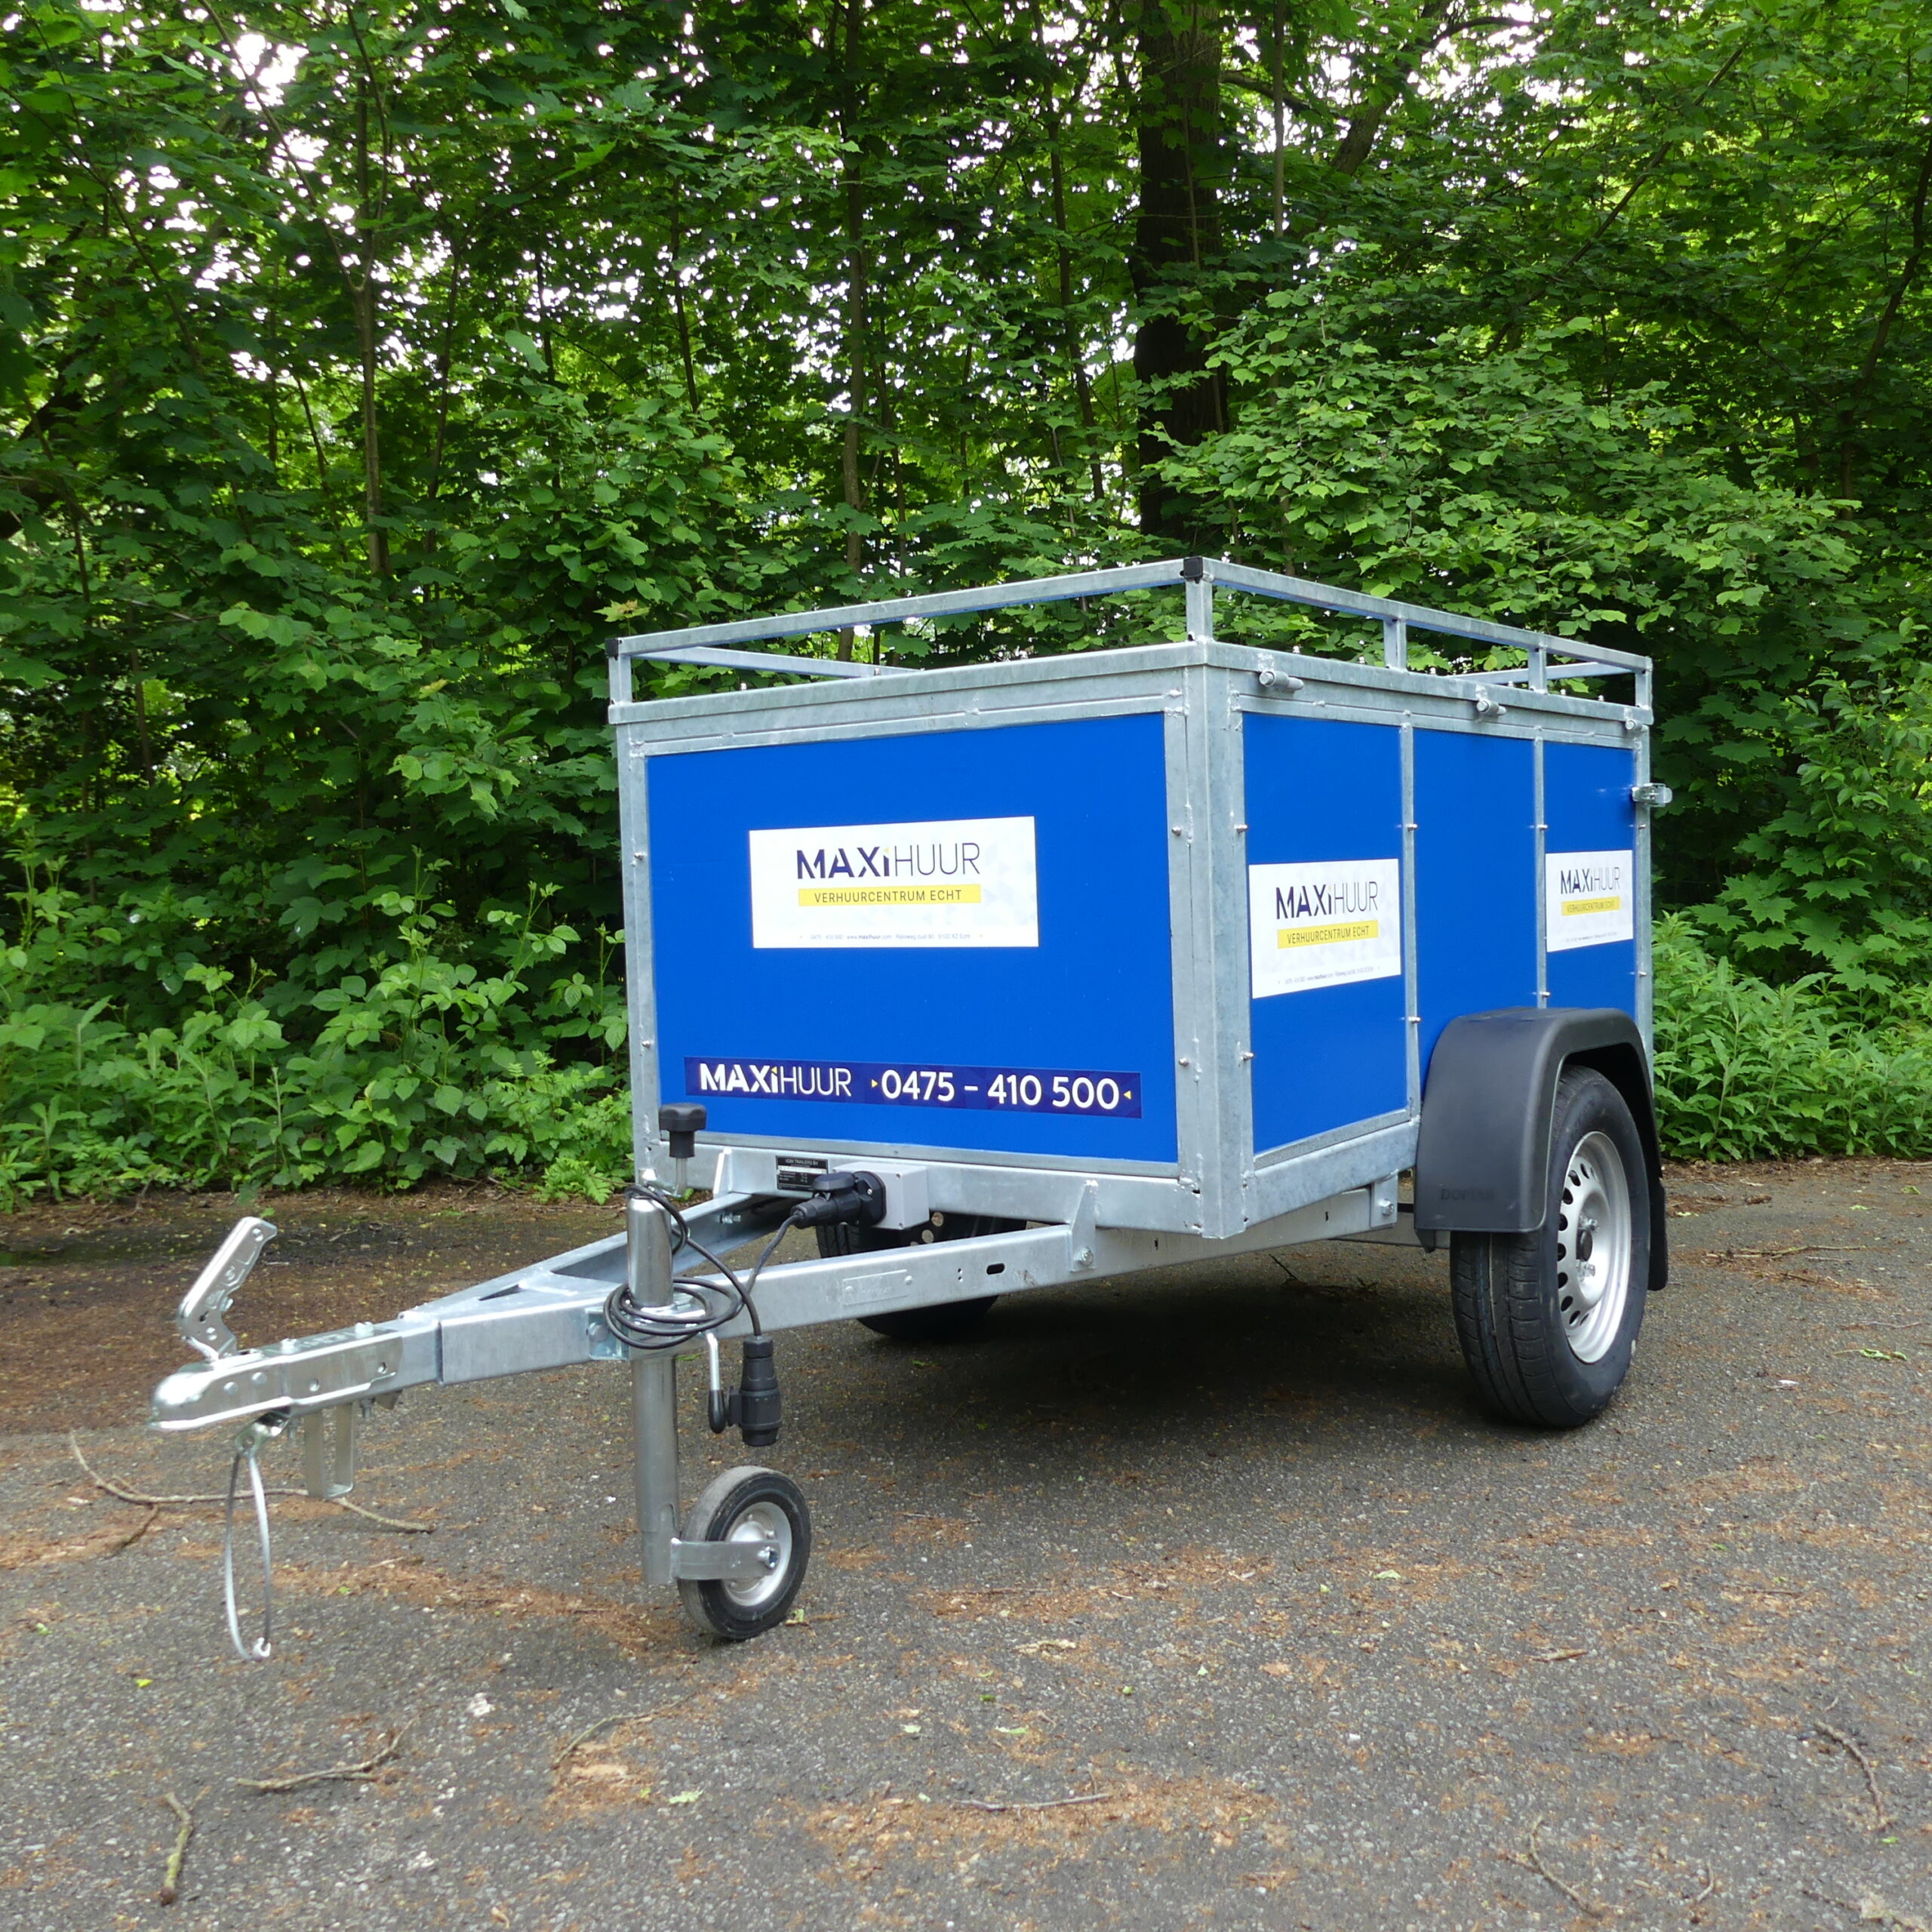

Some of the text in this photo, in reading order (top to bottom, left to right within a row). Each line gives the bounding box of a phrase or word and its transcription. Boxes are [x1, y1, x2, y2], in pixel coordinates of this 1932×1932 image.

[814, 889, 962, 903] VERHUURCENTRUM ECHT
[1287, 925, 1370, 944] VERHUURCENTRUM ECHT
[881, 1069, 955, 1102] 0475
[987, 1073, 1042, 1106] 410
[1052, 1075, 1120, 1110] 500
